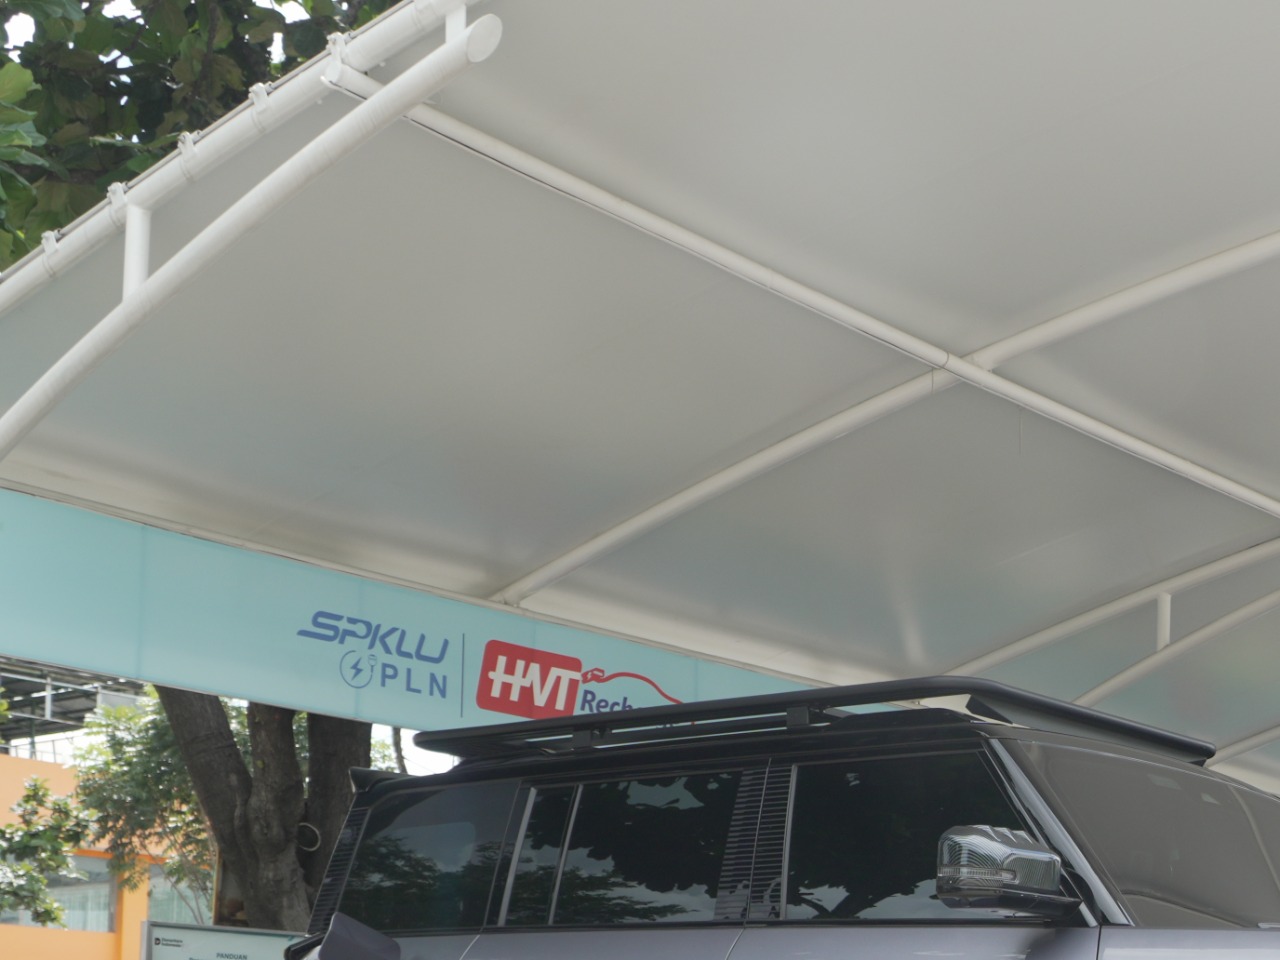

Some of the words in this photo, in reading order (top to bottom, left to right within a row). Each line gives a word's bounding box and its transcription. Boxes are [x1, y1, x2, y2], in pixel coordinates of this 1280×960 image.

[297, 610, 449, 664] SPKLU
[380, 662, 447, 699] PLN
[216, 952, 248, 960] PANDUAN
